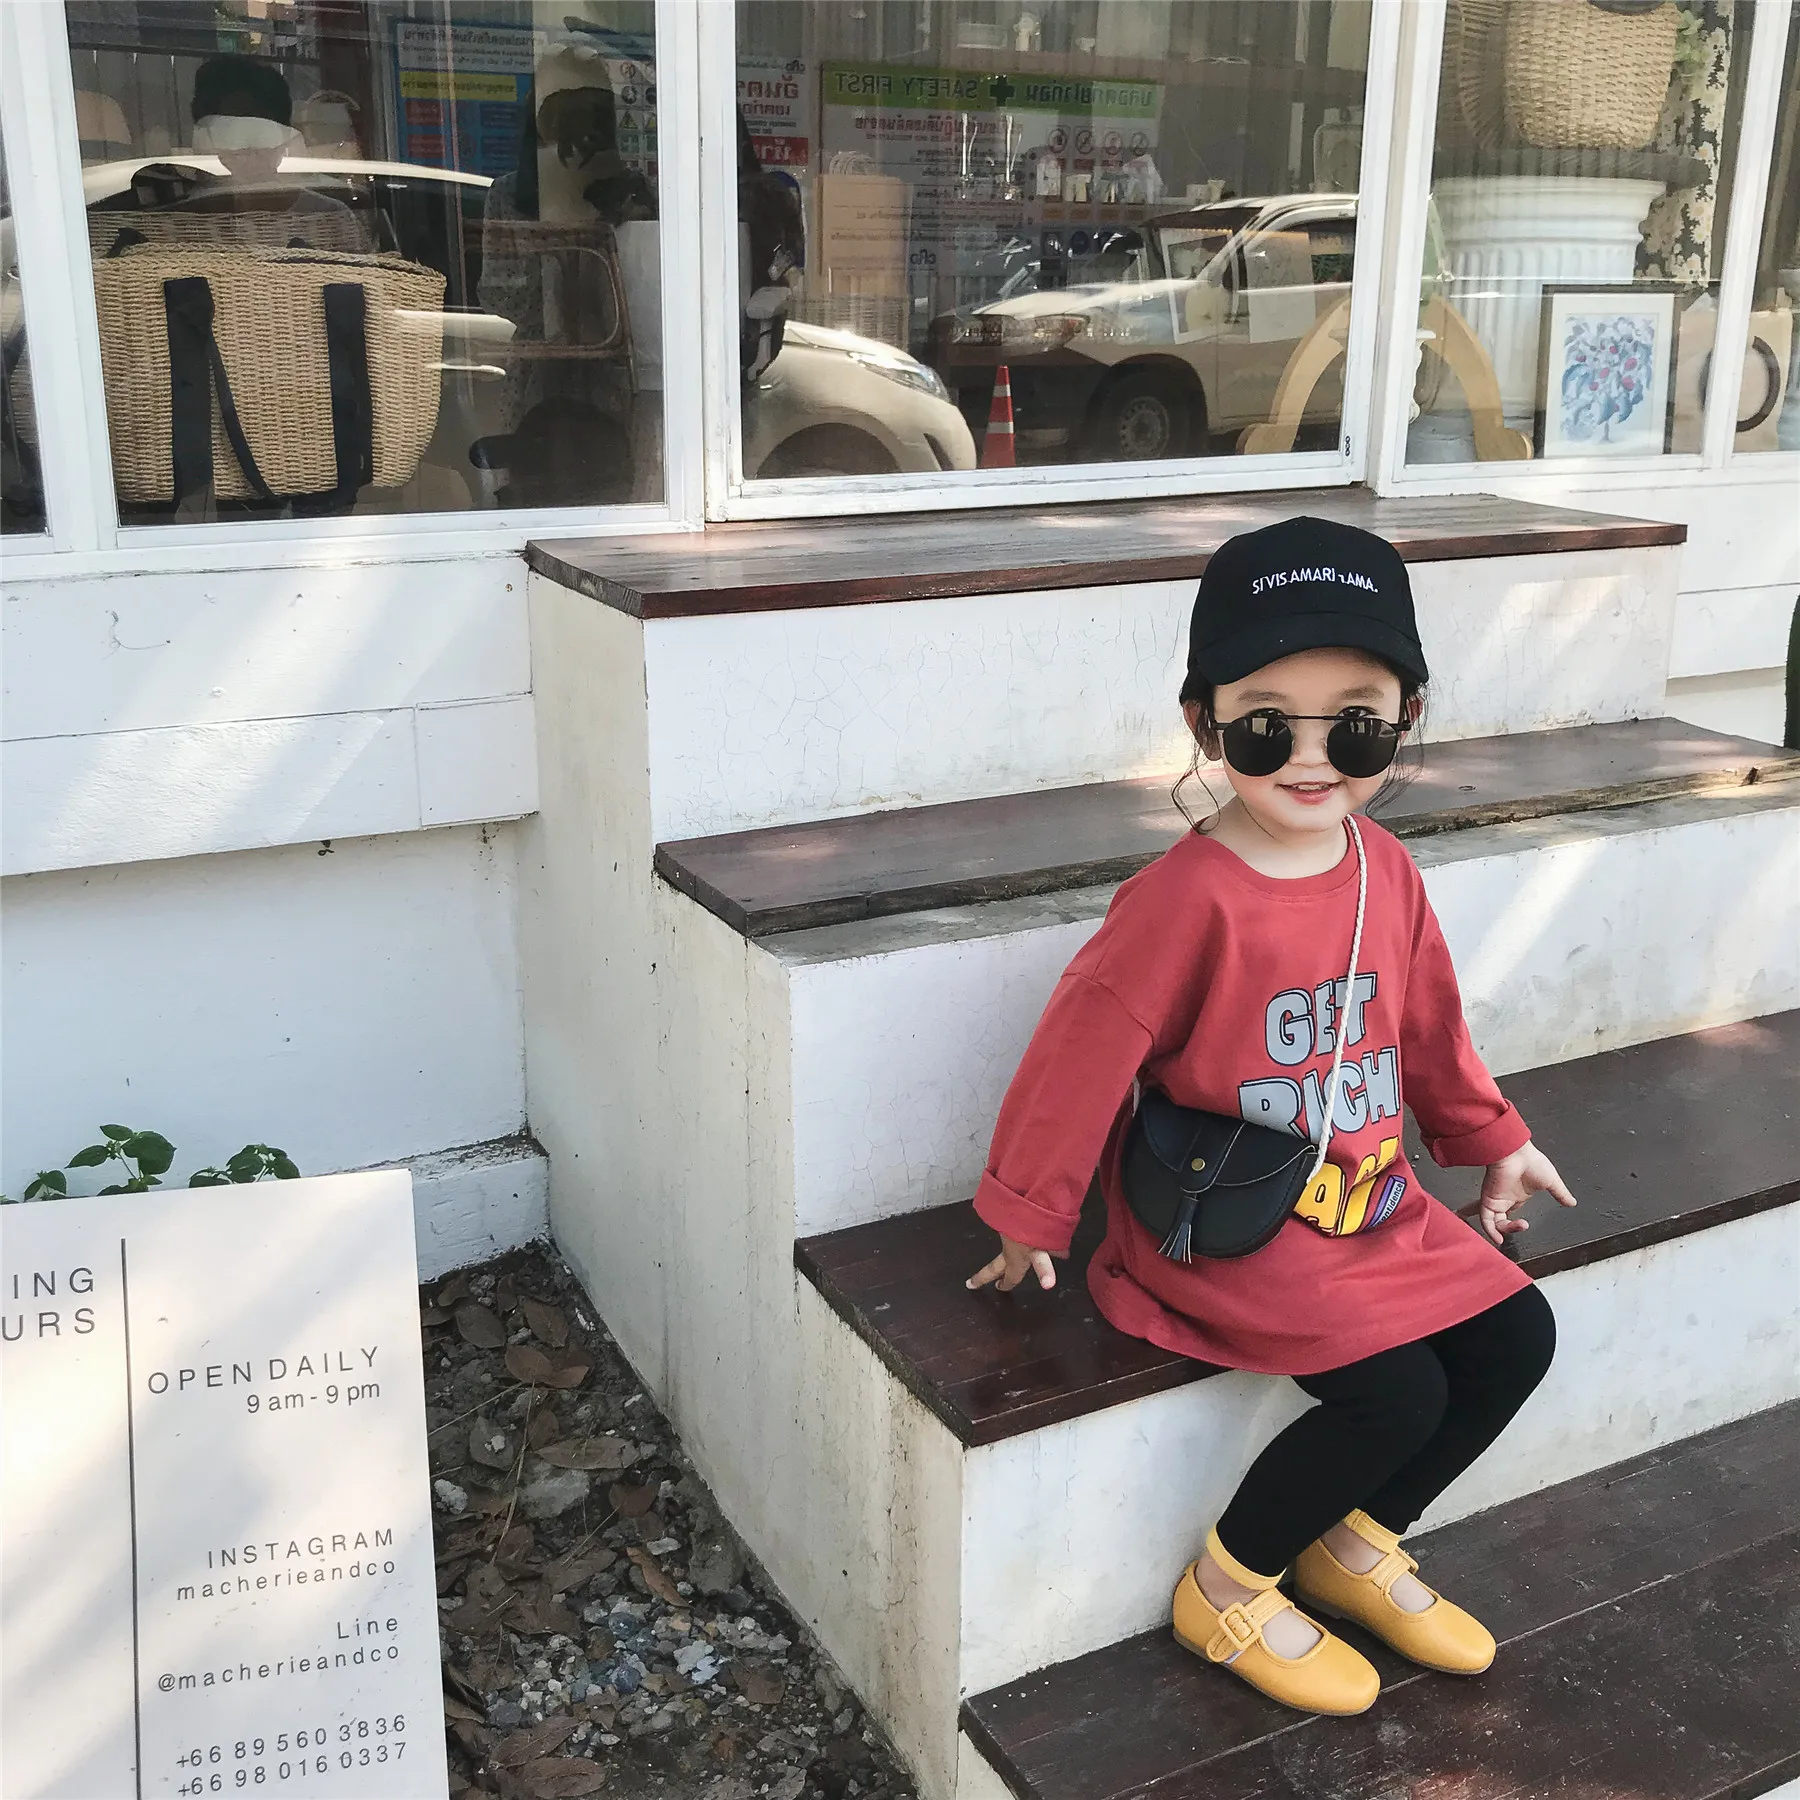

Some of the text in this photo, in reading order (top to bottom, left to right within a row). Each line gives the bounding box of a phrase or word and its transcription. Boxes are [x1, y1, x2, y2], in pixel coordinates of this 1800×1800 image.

[1265, 971, 1378, 1066] GET
[1237, 1045, 1400, 1148] RICH
[13, 1267, 94, 1299] ING
[1, 1307, 95, 1341] URS
[148, 1346, 378, 1395] OPEN DAILY
[208, 1528, 394, 1569] INSTAGRAM
[177, 1560, 396, 1601] macherieandco
[337, 1617, 398, 1640] Line
[158, 1645, 399, 1692] @macherieandco
[176, 1714, 405, 1768] +66 89 560 3836
[178, 1741, 406, 1797] +66 98 016 0337
